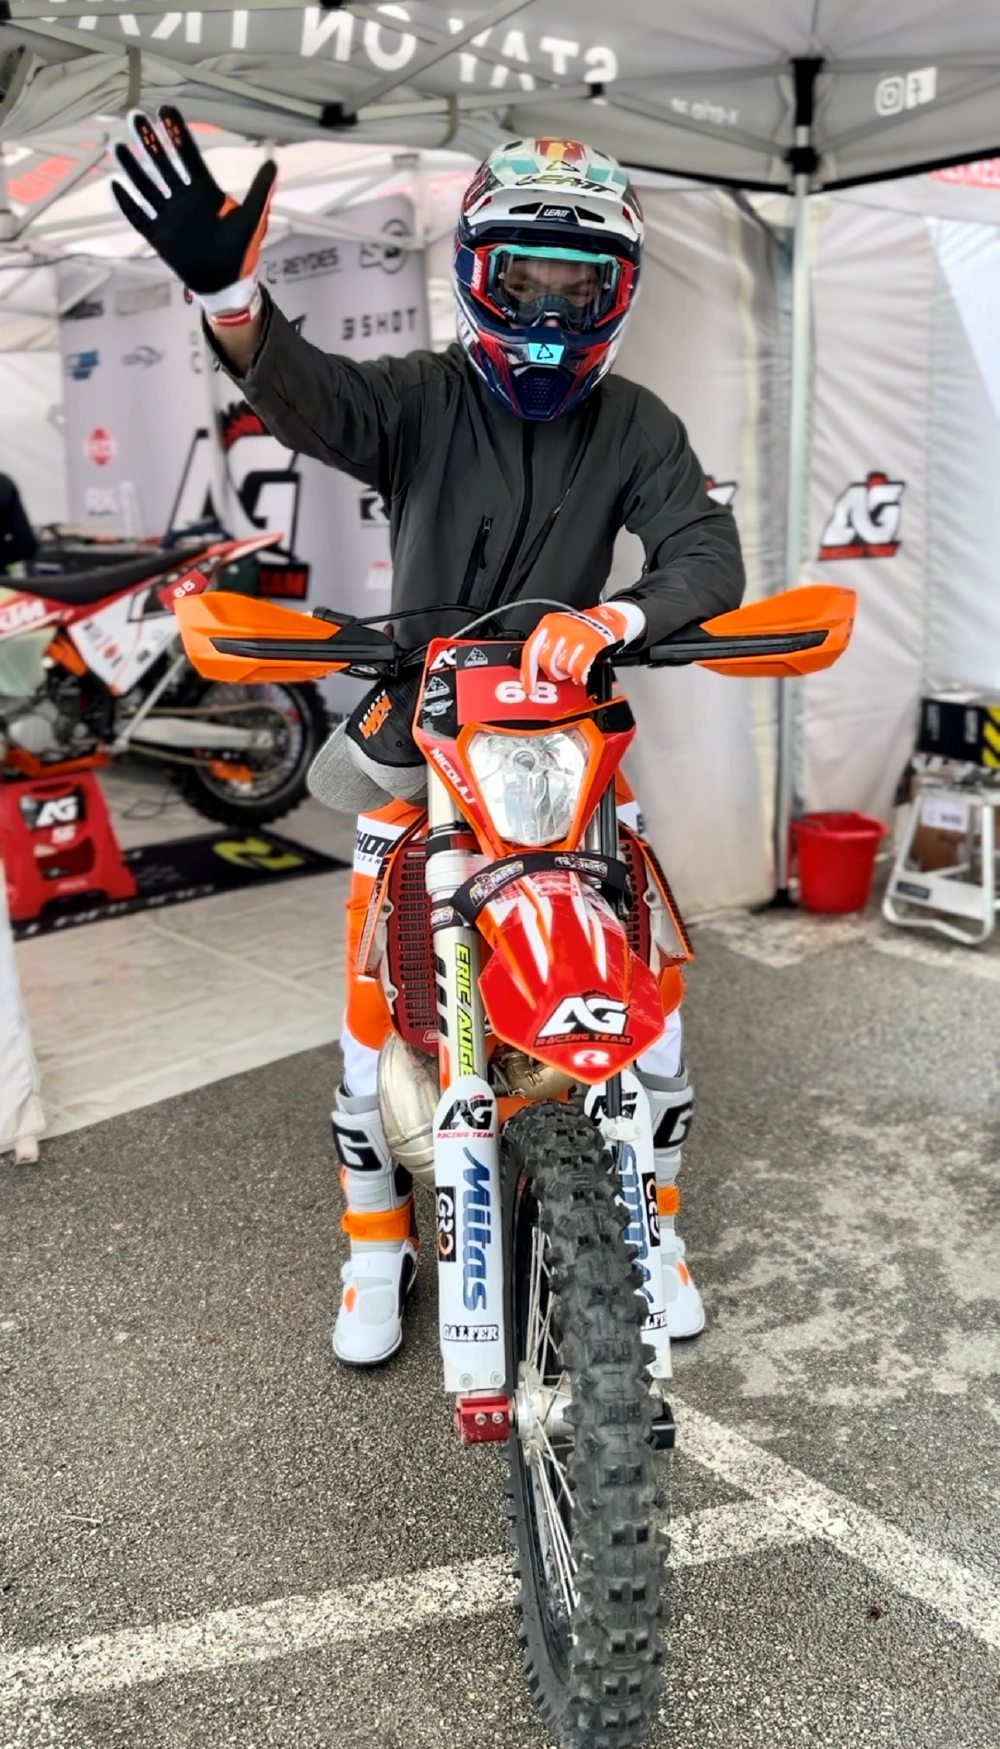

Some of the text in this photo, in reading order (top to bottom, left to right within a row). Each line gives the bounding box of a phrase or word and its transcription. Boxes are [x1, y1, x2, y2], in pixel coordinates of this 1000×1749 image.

[543, 208, 571, 218] LEATT
[172, 579, 197, 599] 65
[455, 942, 472, 1008] ERIC
[536, 995, 628, 1037] AG
[535, 1033, 632, 1047] RACING TEAM
[438, 1096, 494, 1130] AG
[437, 1132, 494, 1140] RACING TEAM
[462, 1146, 492, 1312] Mitas
[443, 1323, 500, 1342] GALFER
